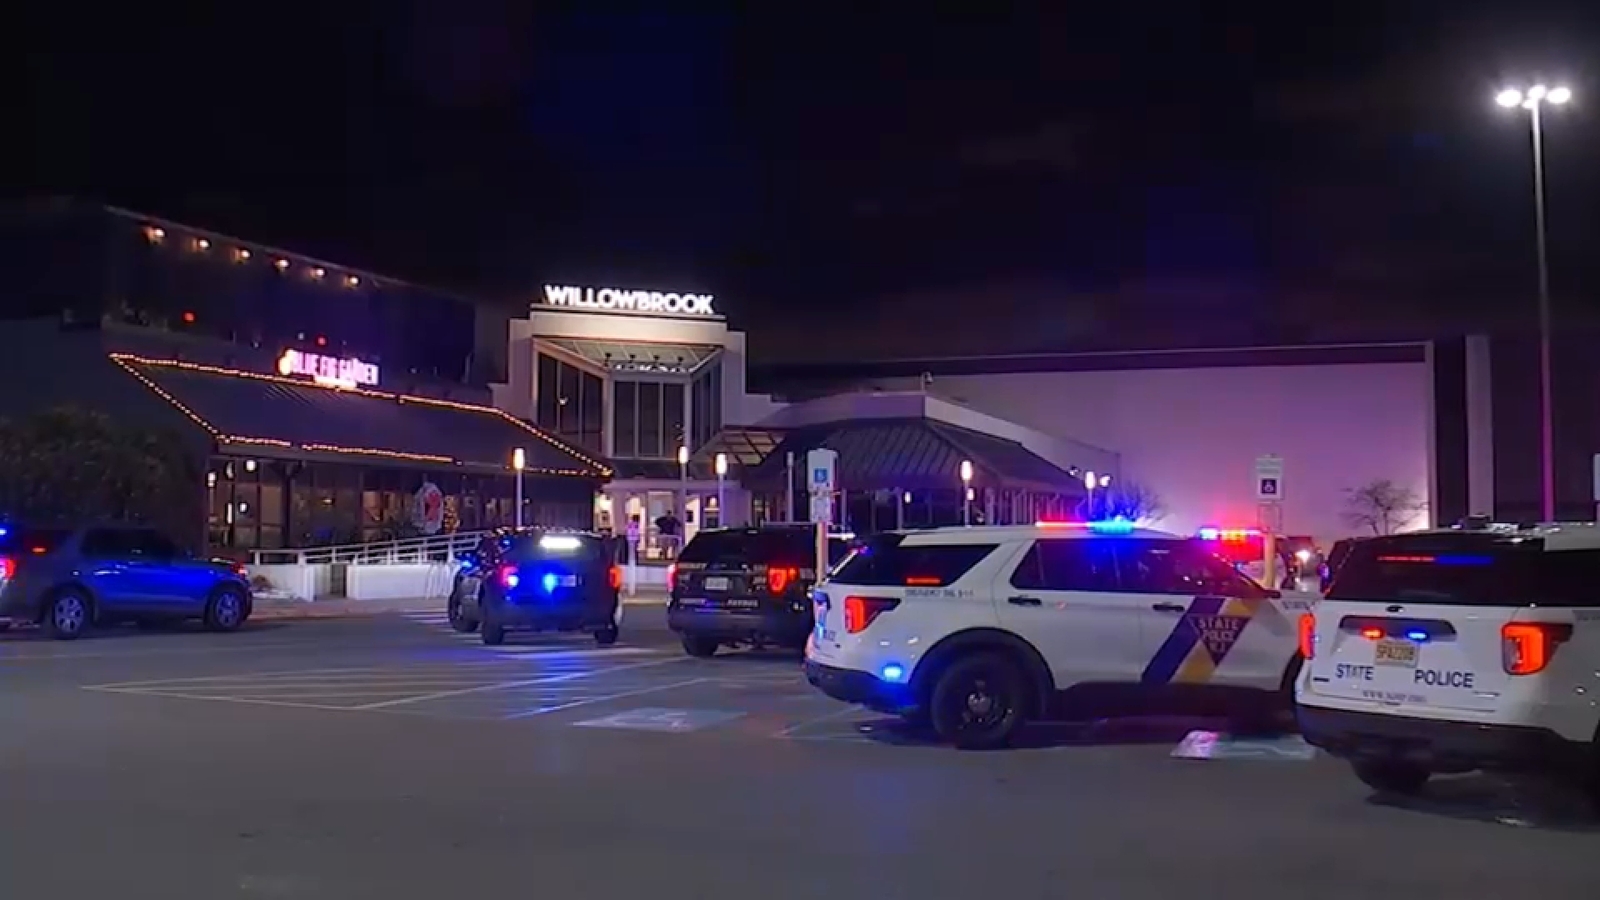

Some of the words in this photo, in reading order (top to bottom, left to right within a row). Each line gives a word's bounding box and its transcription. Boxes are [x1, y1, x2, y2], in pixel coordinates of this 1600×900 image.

[544, 284, 714, 314] WILLOWBROOK
[1199, 616, 1239, 630] STATE
[1202, 629, 1234, 642] POLICE
[1336, 662, 1375, 681] STATE
[1414, 668, 1475, 689] POLICE
